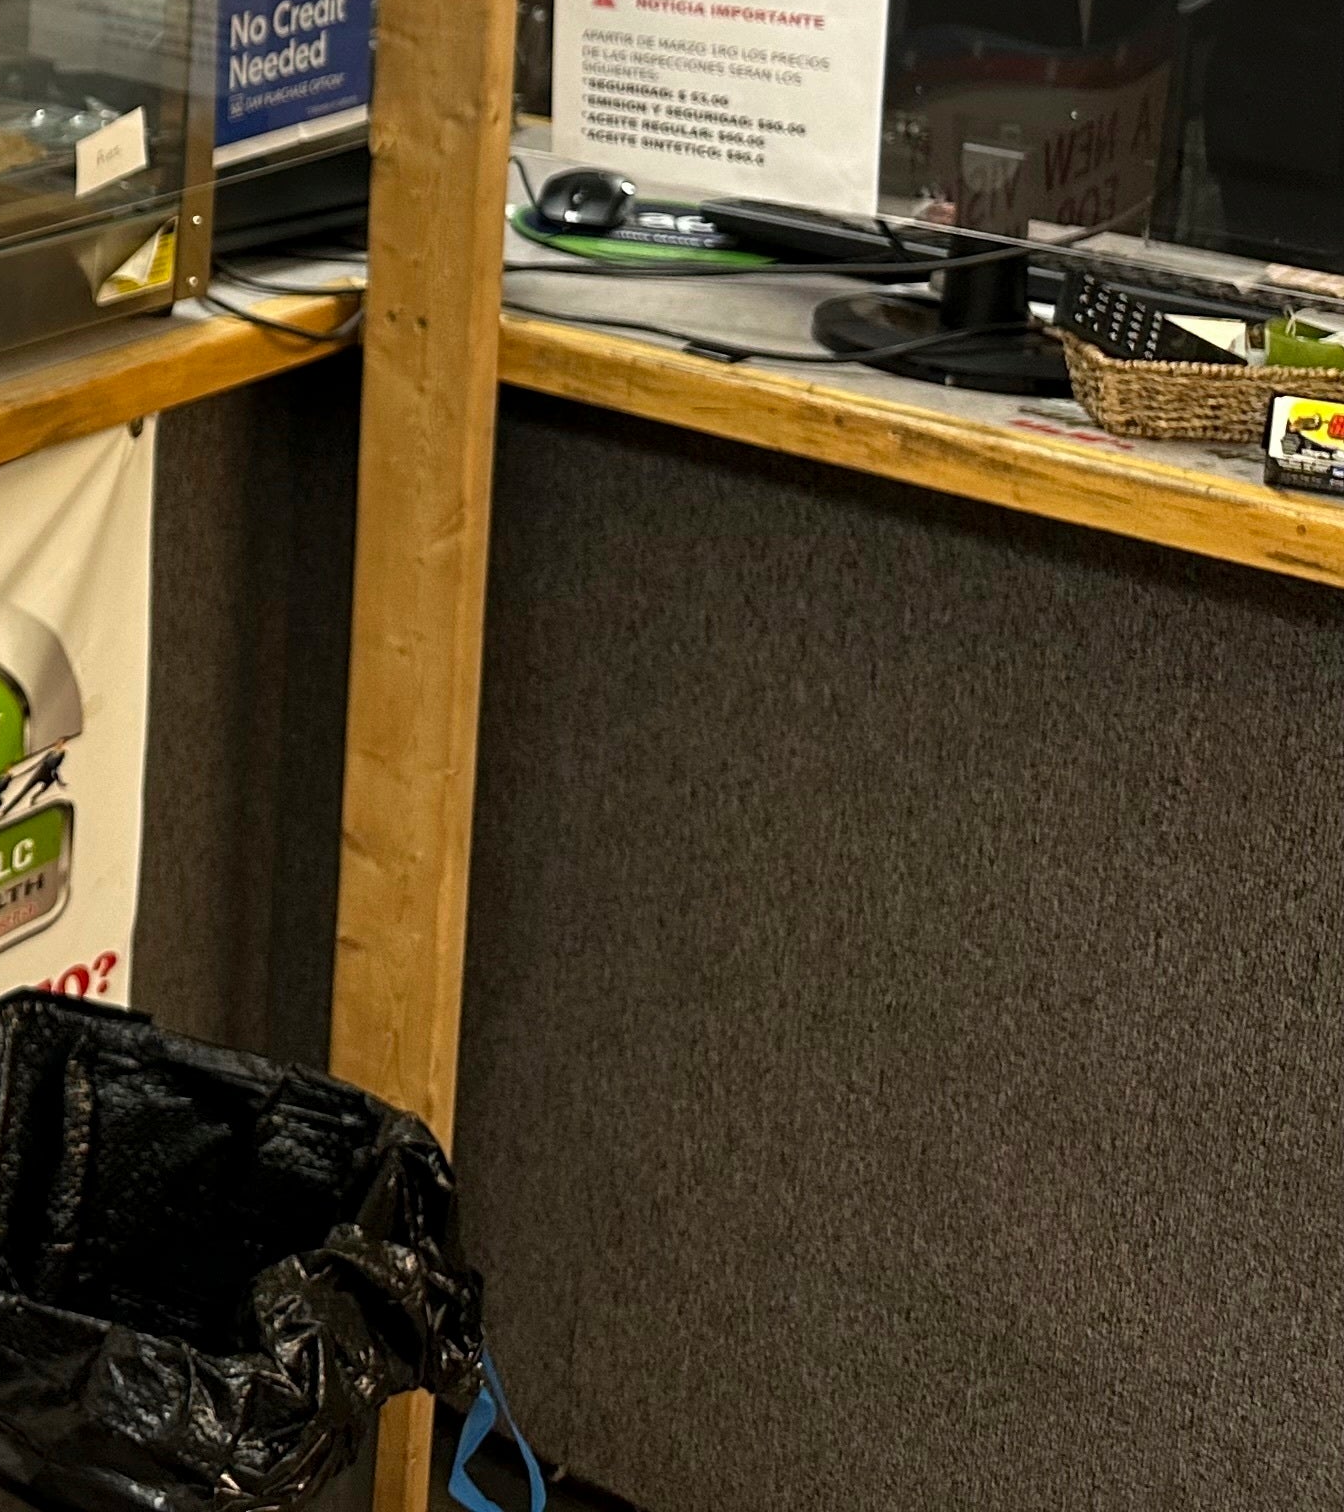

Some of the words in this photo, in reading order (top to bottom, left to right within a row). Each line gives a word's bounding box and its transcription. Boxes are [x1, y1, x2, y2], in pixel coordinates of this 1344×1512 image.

[230, 10, 268, 50] No
[710, 3, 826, 31] IMPORTANTE
[229, 29, 329, 92] Needed
